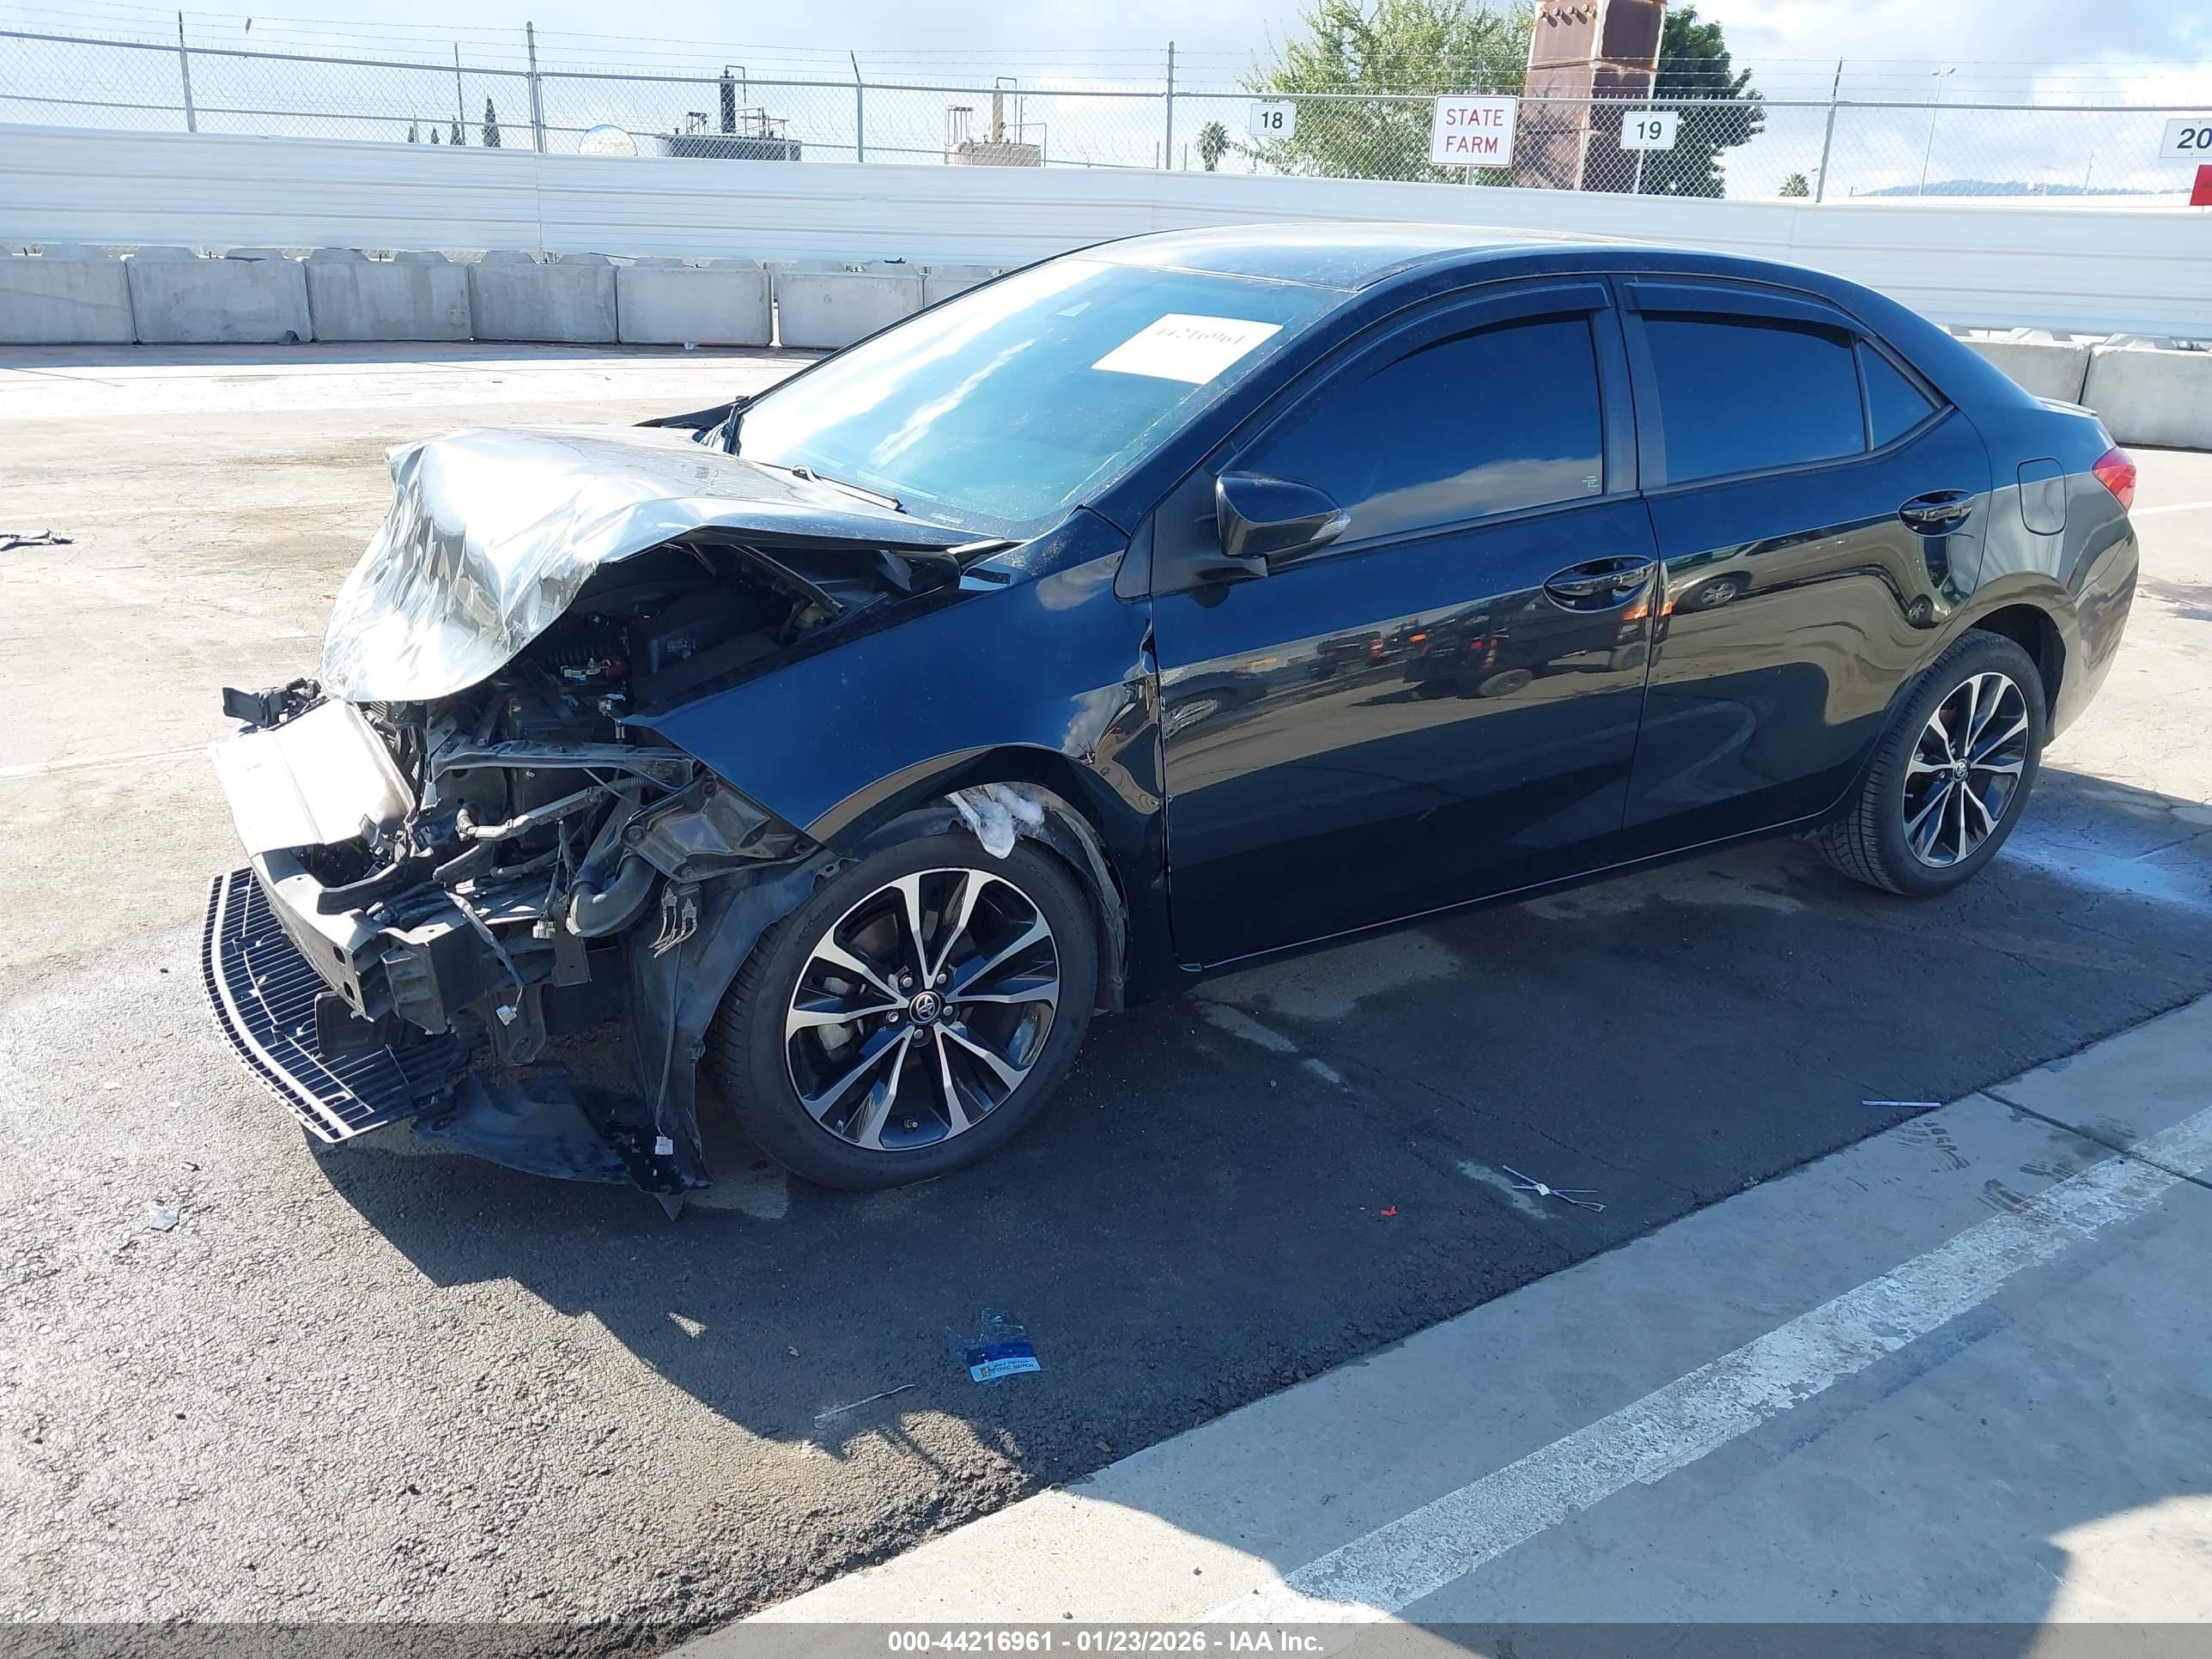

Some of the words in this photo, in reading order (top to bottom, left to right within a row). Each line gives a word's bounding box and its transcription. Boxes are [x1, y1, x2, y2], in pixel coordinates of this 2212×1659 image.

[1261, 111, 1283, 129] 18
[1445, 108, 1504, 126] STATE
[1637, 120, 1662, 140] 19
[2177, 128, 2212, 149] 20
[1445, 136, 1498, 154] FARM
